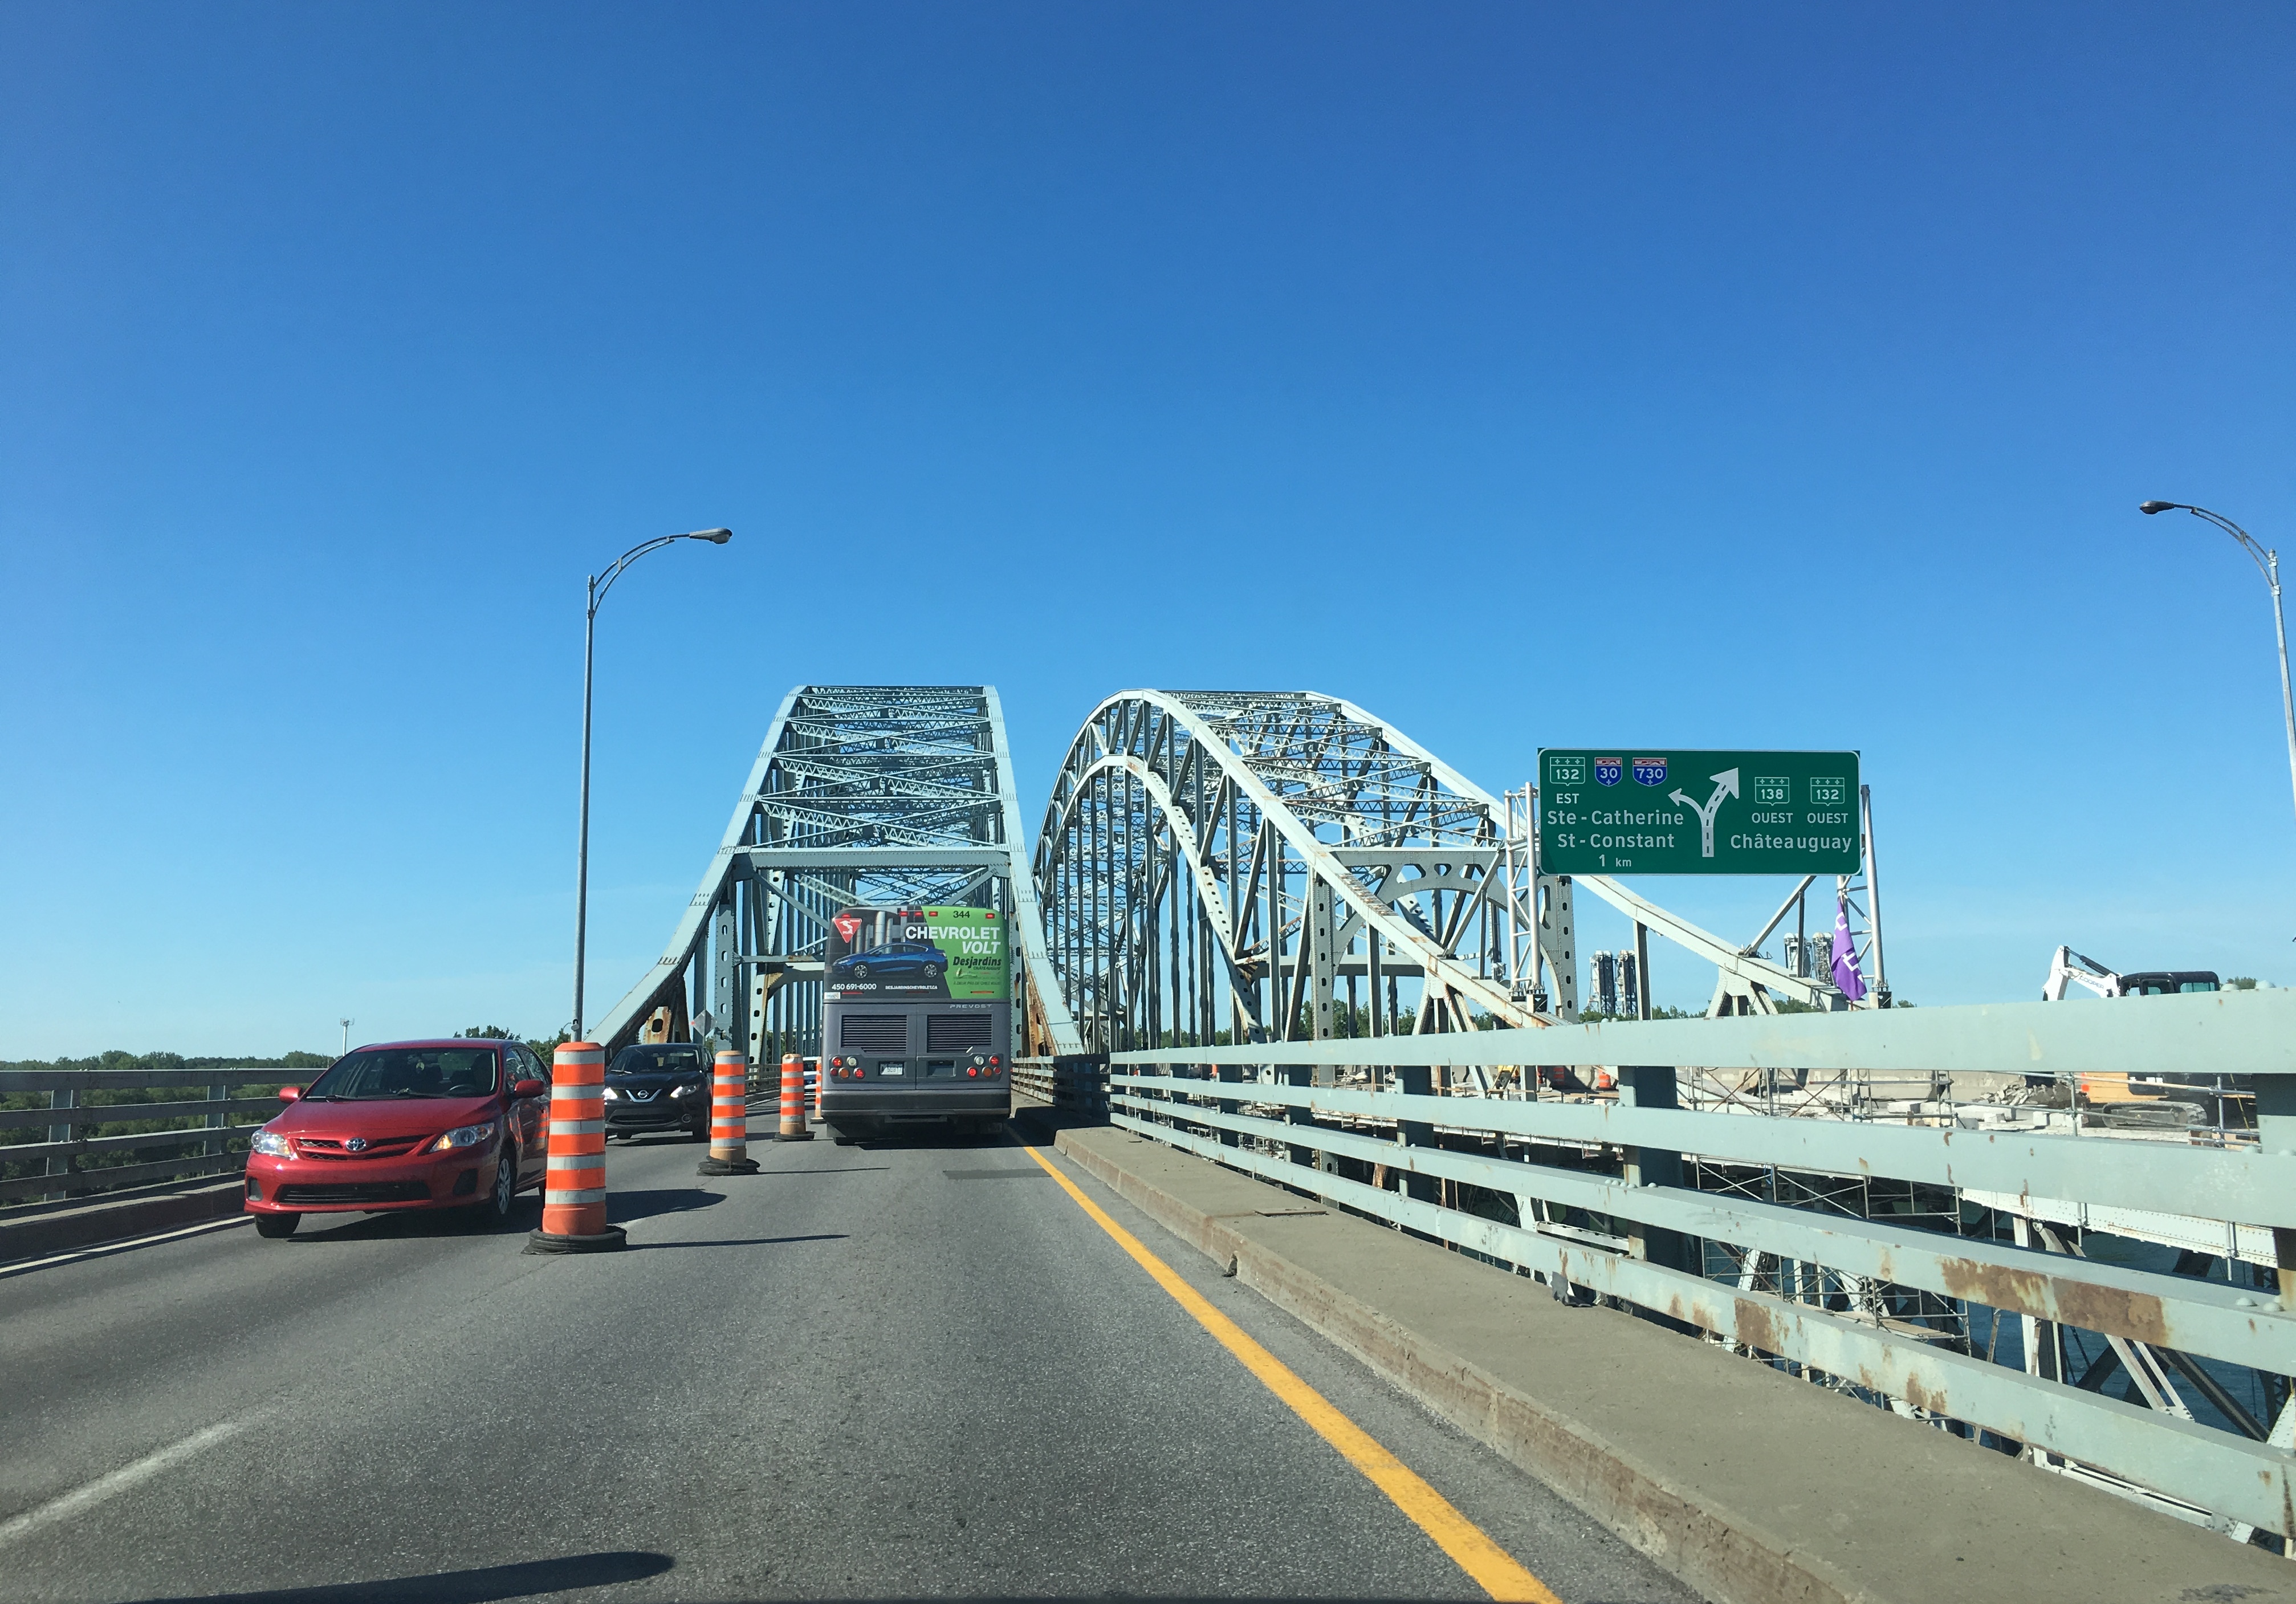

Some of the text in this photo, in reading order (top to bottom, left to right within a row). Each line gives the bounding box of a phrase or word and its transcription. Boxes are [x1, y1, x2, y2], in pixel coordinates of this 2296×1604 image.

[1556, 769, 1579, 780] 132
[1600, 768, 1618, 779] 30
[1636, 768, 1663, 779] 730
[1556, 793, 1579, 804] EST
[1761, 788, 1784, 800] 138
[1817, 789, 1839, 800] 132
[1752, 812, 1793, 824] OUEST
[1807, 813, 1849, 824] OUEST
[1731, 833, 1852, 853] Châteauguay
[1599, 854, 1632, 867] 1 km
[905, 926, 1000, 939] CHEVROLET
[962, 941, 1001, 954] VOLT
[952, 956, 1002, 969] Desjardins
[2079, 975, 2104, 990] COOPER
